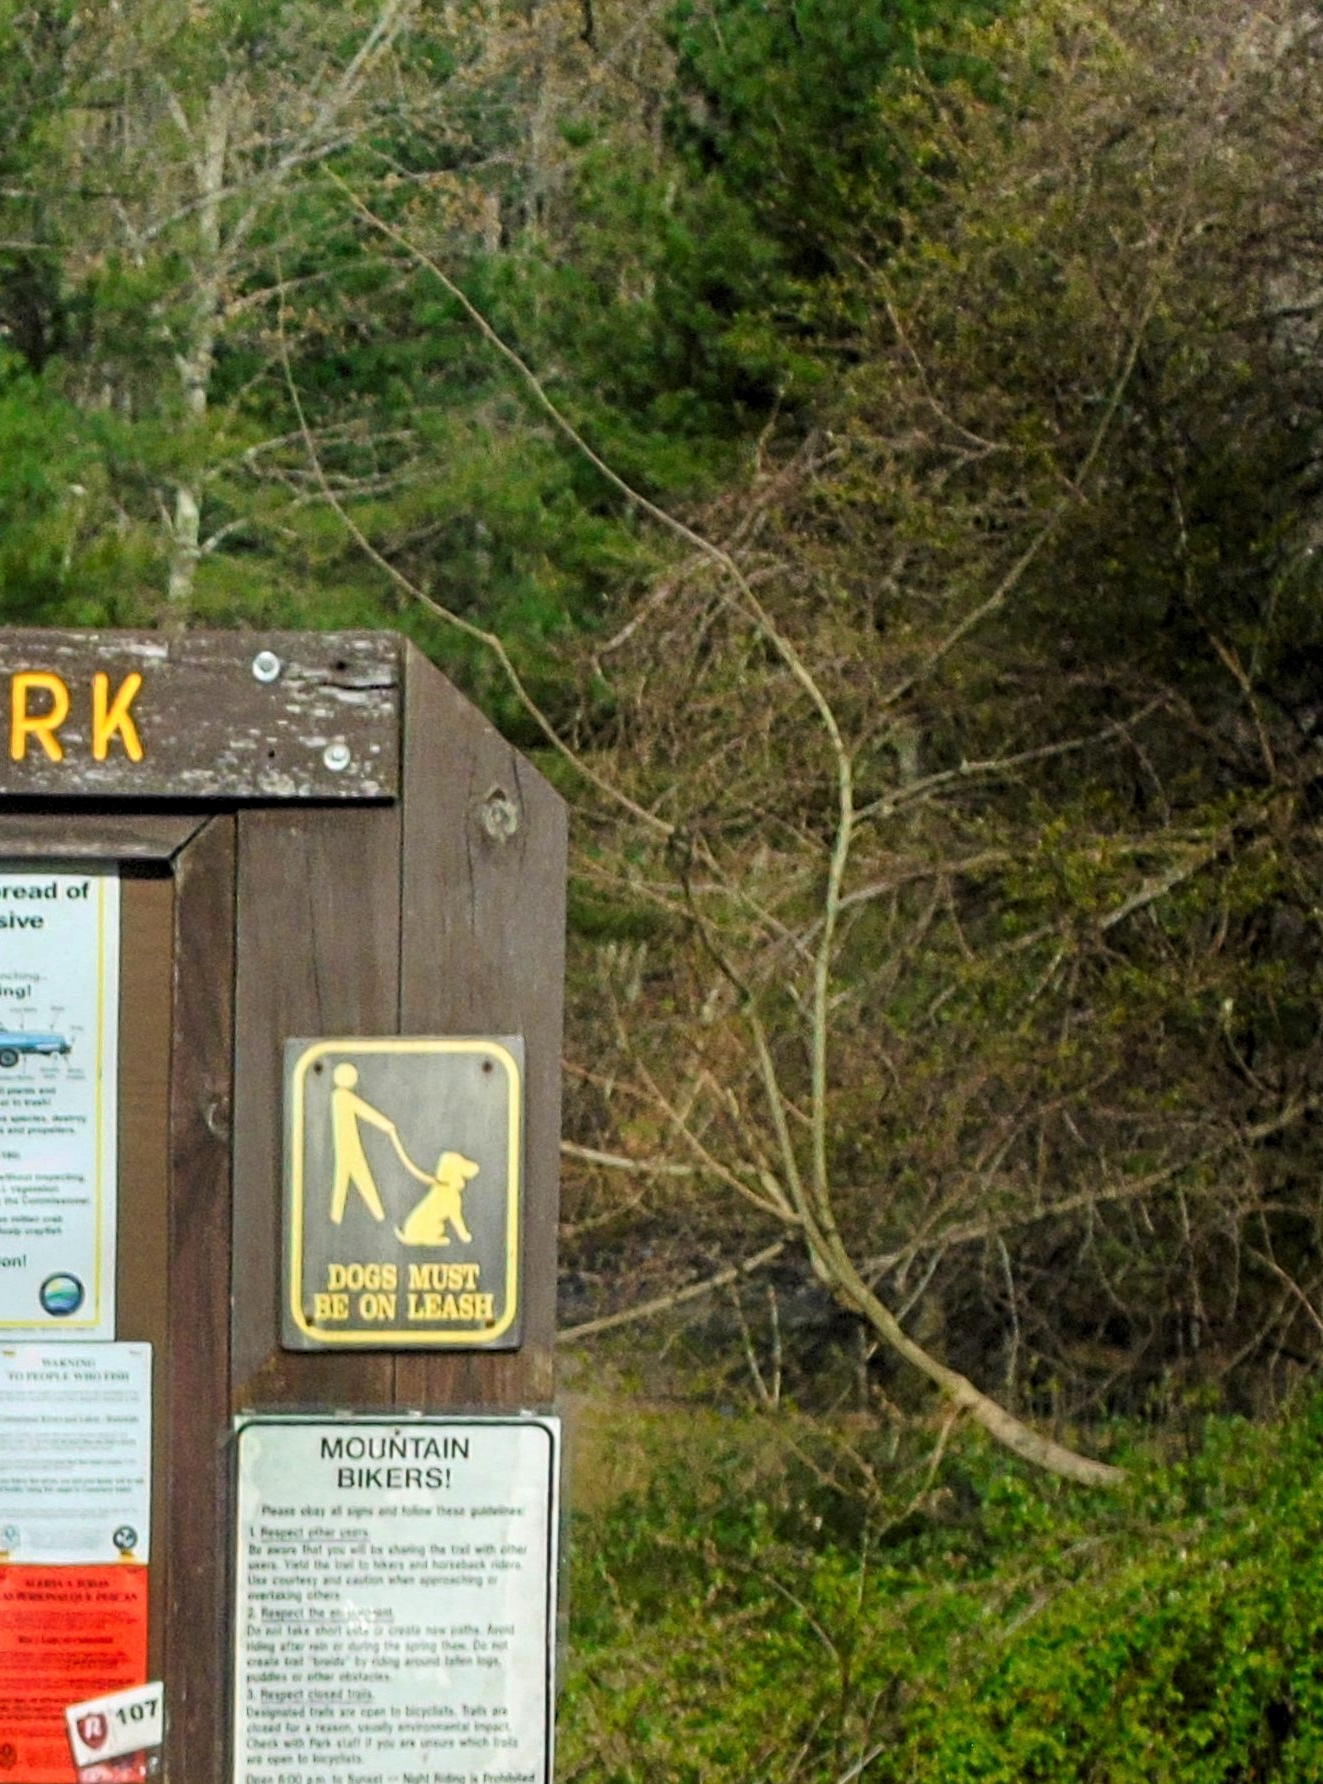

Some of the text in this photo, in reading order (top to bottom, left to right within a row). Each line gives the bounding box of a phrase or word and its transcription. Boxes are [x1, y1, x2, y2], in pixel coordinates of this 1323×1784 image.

[66, 881, 90, 899] of
[328, 1263, 480, 1290] DOGS MUST
[314, 1293, 493, 1320] BE ON LEASH
[42, 1359, 95, 1367] WARNING
[321, 1438, 469, 1459] MOUNTAIN
[337, 1468, 451, 1488] BIKERS!
[262, 1506, 295, 1517] Please
[331, 1506, 342, 1517] all
[347, 1506, 373, 1519] signs
[379, 1506, 397, 1517] and
[403, 1506, 431, 1517] follow
[437, 1506, 464, 1517] these
[261, 1527, 303, 1540] Respect
[309, 1527, 334, 1538] other
[249, 1545, 527, 1557] Be aware that you will be sharing the trail with other
[261, 1690, 303, 1702] Respect
[309, 1690, 342, 1700] closed
[116, 1700, 158, 1725] 107
